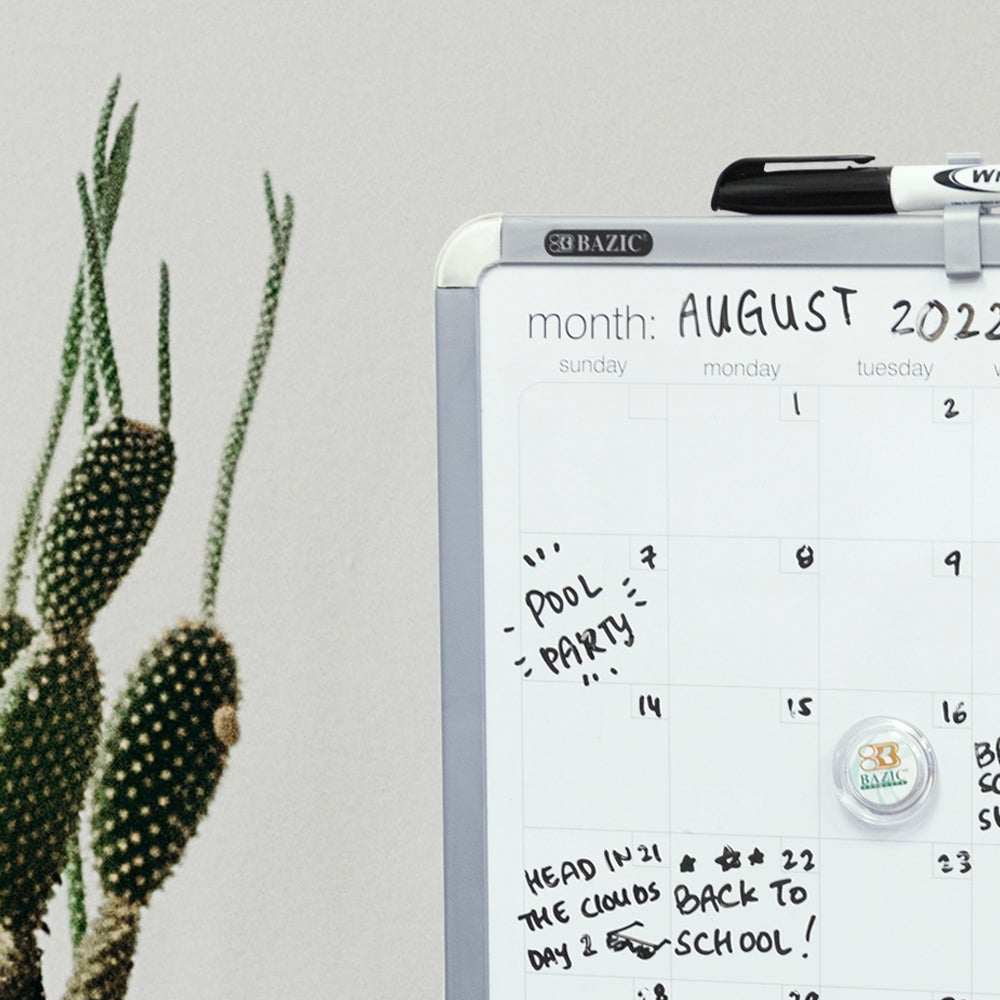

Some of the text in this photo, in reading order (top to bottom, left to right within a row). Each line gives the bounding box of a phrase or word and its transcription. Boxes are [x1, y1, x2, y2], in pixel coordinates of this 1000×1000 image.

[577, 233, 642, 253] BAZIC
[529, 305, 655, 340] month:
[679, 286, 858, 337] AUGUST
[559, 355, 628, 378] sunday
[703, 358, 782, 382] monday
[857, 358, 935, 382] tuesday
[793, 392, 801, 416] 1
[943, 398, 960, 419] 2
[639, 544, 657, 570] 7
[795, 544, 814, 570] 8
[944, 550, 962, 577] 9
[524, 574, 604, 628] POOL
[539, 613, 635, 675] PARTY
[638, 694, 662, 719] 14
[787, 697, 813, 717] 15
[942, 700, 968, 725] 16
[860, 769, 905, 786] BAZIC
[637, 843, 662, 863] 21
[781, 848, 816, 872] 22
[937, 850, 972, 874] 23
[524, 846, 633, 896] HEAD IN
[673, 878, 808, 916] BACK TO
[517, 903, 570, 932] THE
[527, 942, 573, 971] DAY
